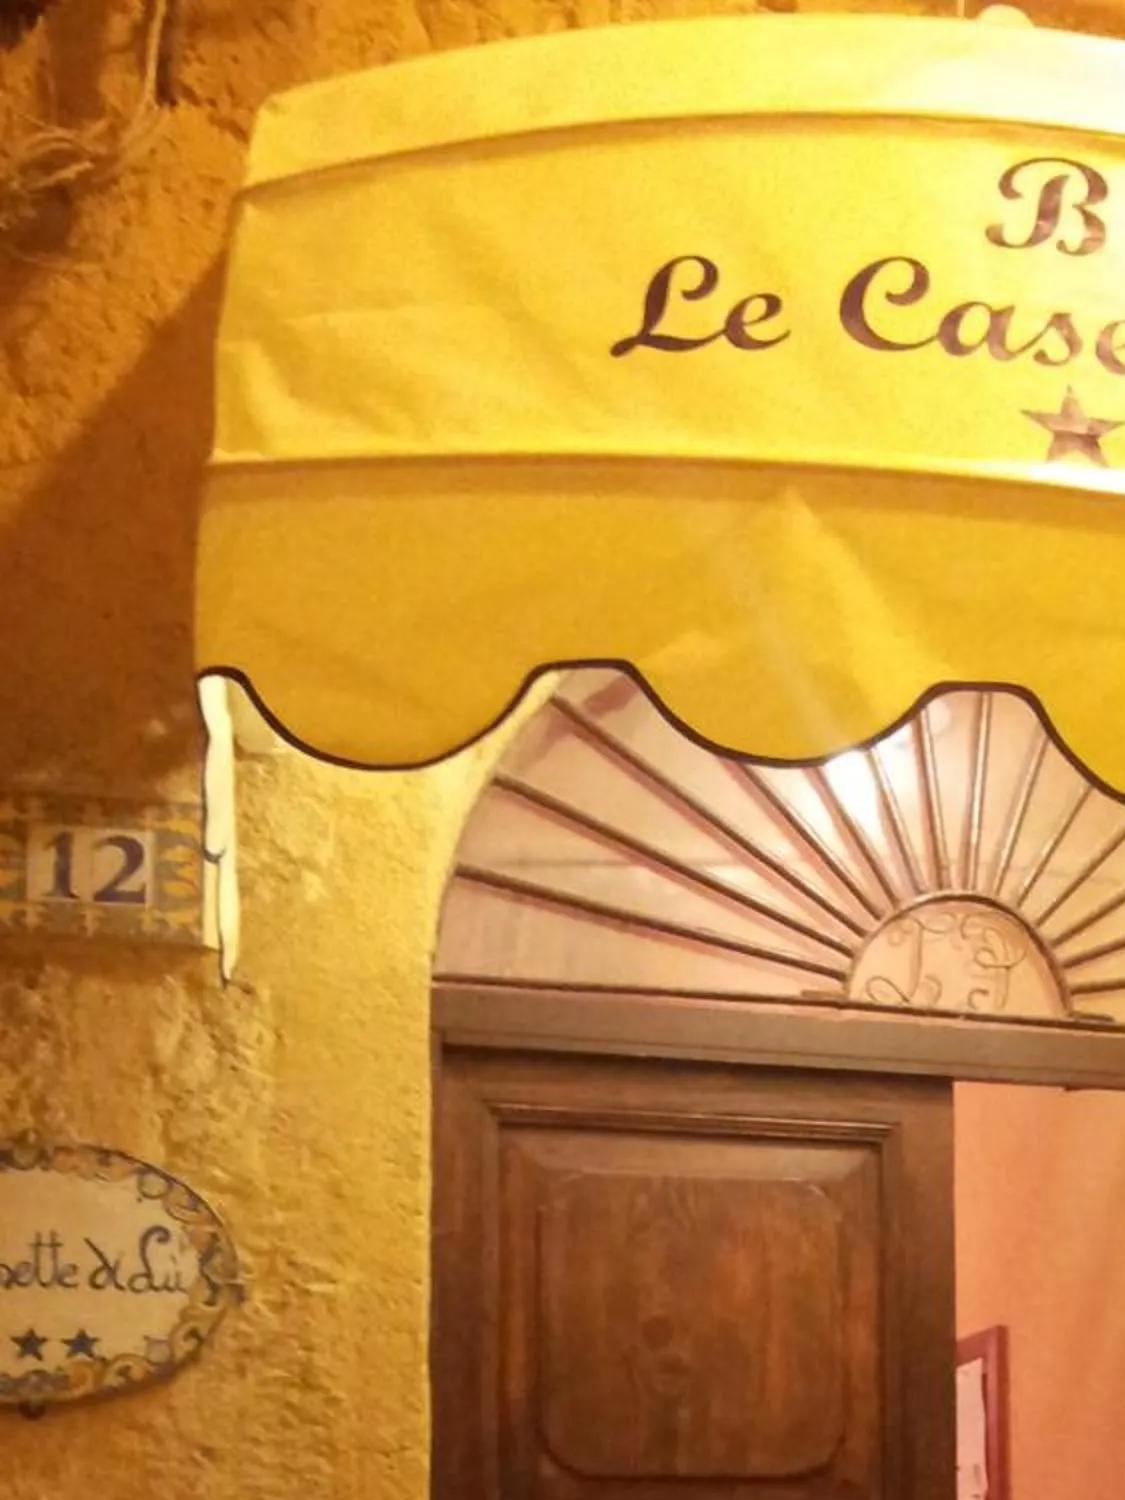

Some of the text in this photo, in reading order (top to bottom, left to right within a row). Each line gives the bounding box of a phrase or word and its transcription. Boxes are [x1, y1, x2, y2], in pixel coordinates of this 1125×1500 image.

[985, 156, 1109, 254] B
[607, 255, 791, 359] Le
[45, 830, 146, 904] 12
